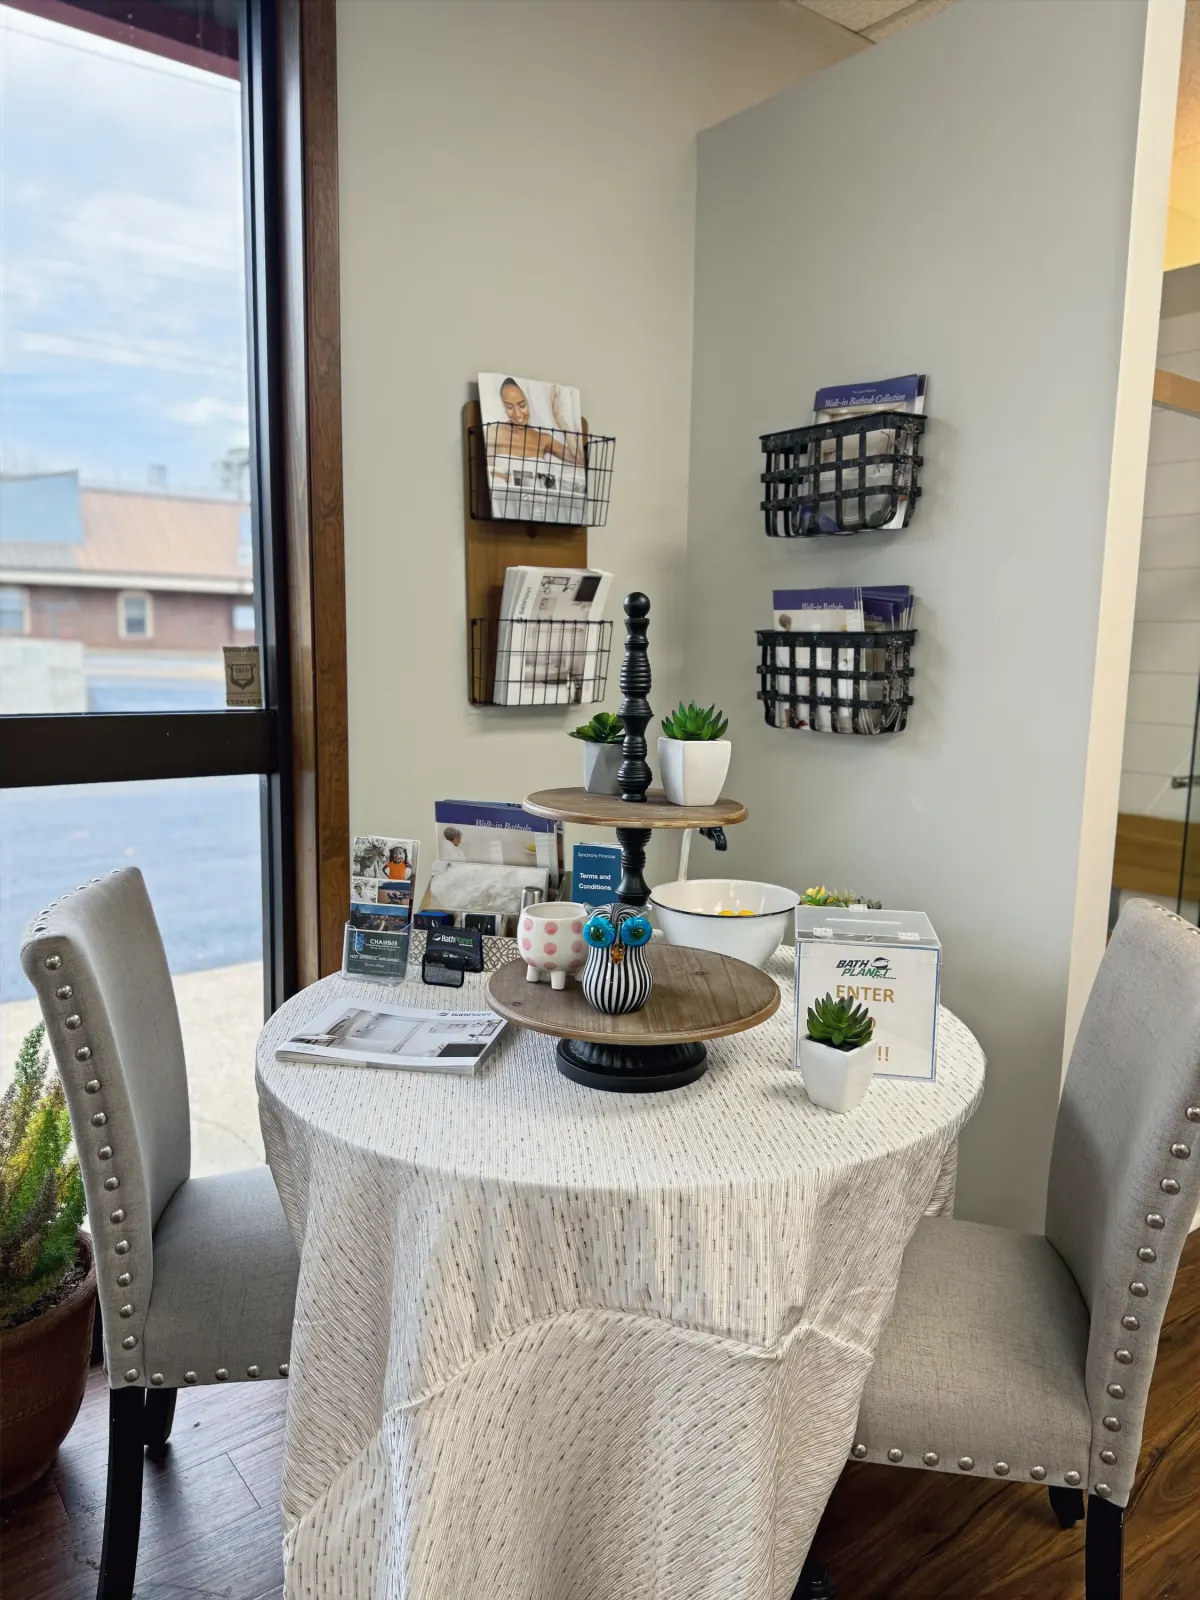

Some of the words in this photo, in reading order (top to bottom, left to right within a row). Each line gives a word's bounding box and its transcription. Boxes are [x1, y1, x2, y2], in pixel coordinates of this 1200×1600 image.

[824, 398, 849, 408] Walk-in
[849, 396, 875, 406] Bathtub
[875, 393, 906, 403] Collection
[475, 818, 503, 829] Walk-in
[579, 872, 599, 880] Terms
[578, 882, 612, 891] Conditions
[369, 938, 398, 946] CHAMBER
[836, 959, 870, 968] BATH
[841, 967, 892, 977] PLANET
[835, 984, 895, 1003] ENTER
